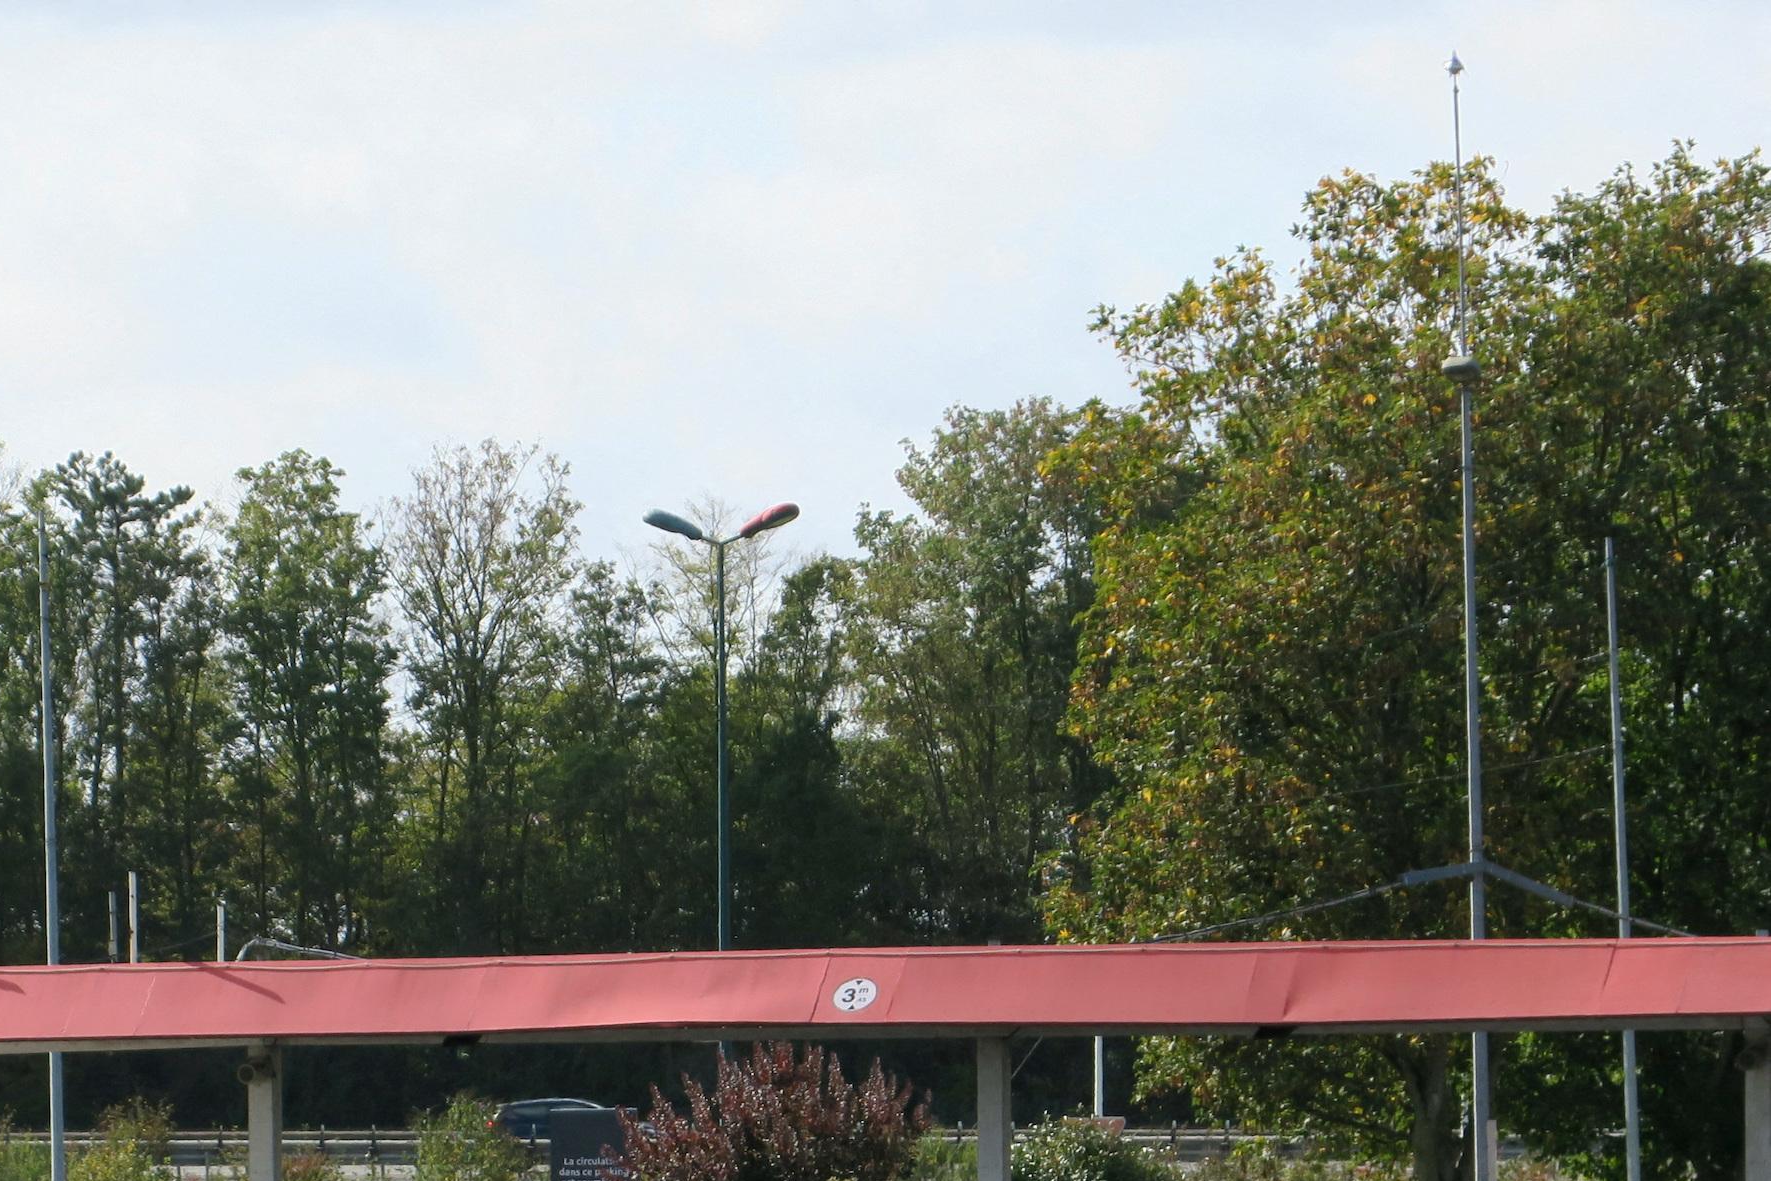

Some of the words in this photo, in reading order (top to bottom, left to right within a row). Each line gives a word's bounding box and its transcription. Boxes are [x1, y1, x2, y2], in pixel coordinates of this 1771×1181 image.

[842, 988, 856, 1002] 3
[559, 1167, 581, 1176] dans
[582, 1168, 593, 1176] ce
